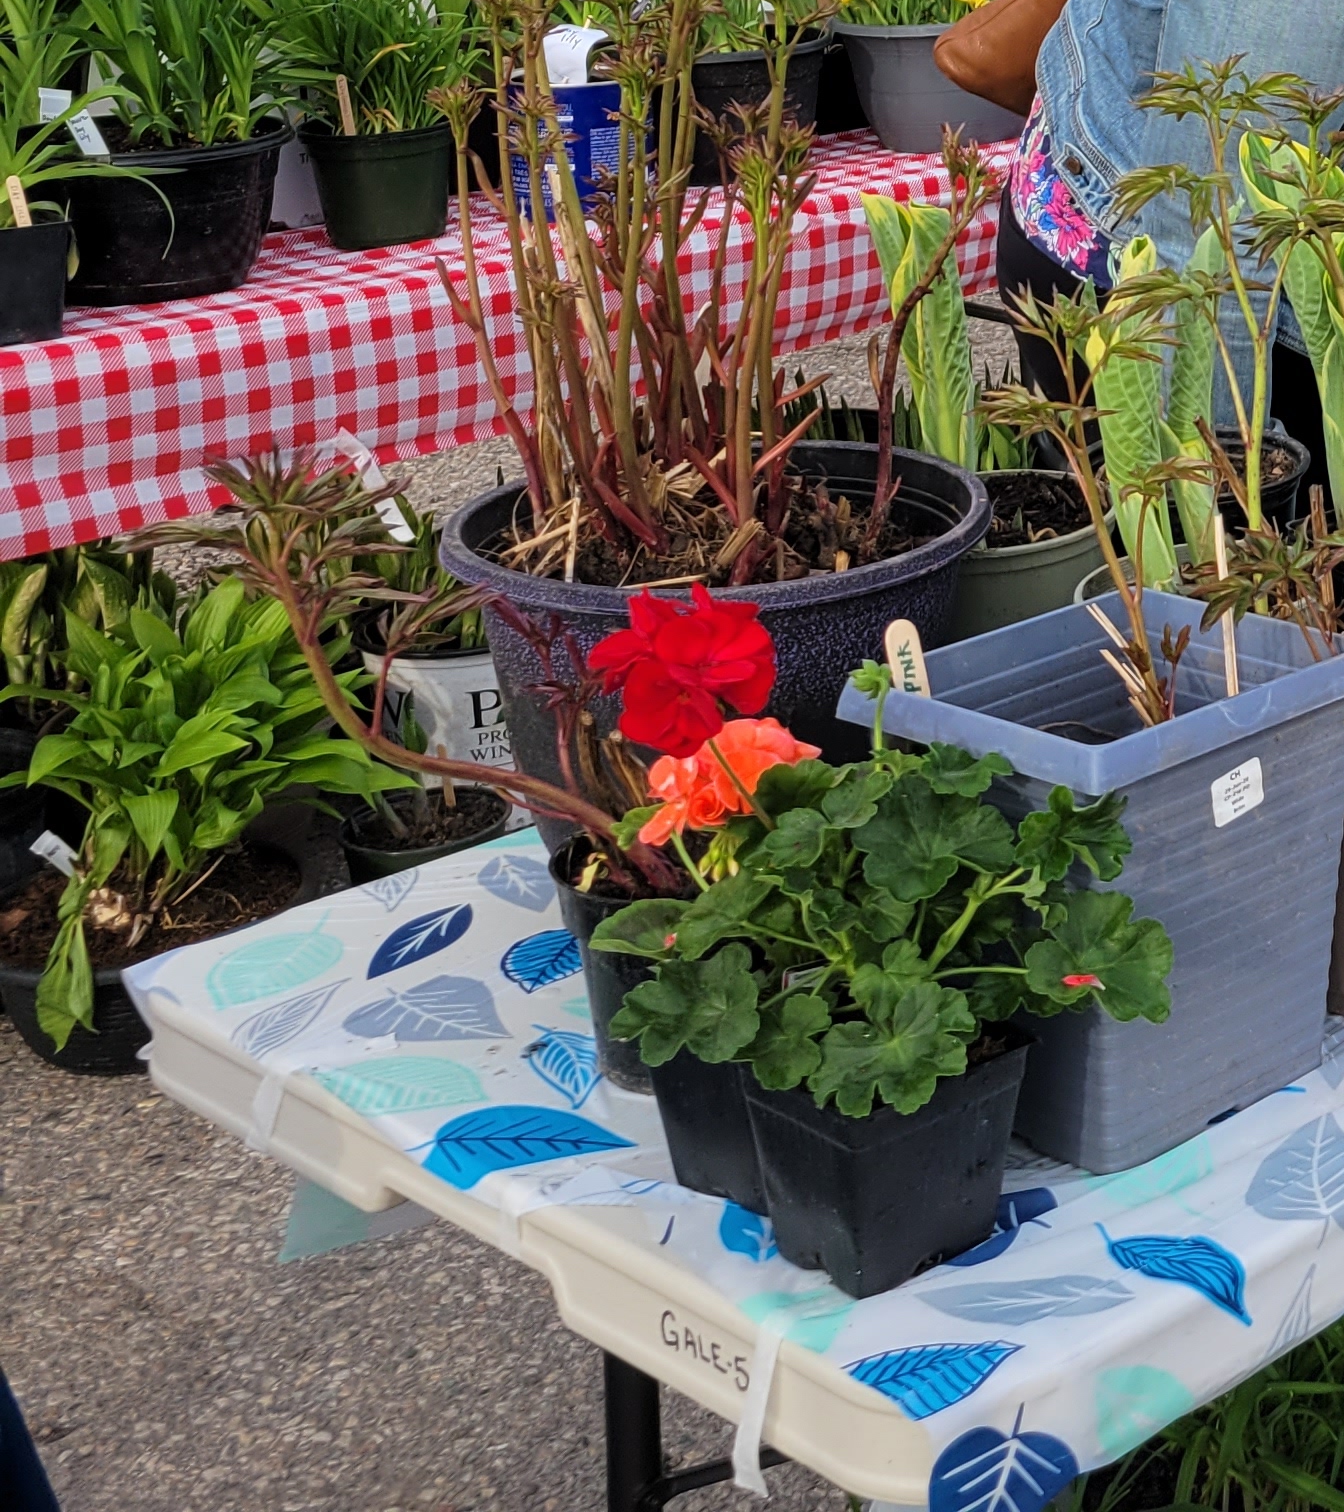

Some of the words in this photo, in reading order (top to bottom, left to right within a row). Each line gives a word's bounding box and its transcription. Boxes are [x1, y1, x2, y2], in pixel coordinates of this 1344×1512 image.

[897, 639, 922, 692] PINK
[470, 744, 513, 762] WIN
[1230, 769, 1241, 780] CH
